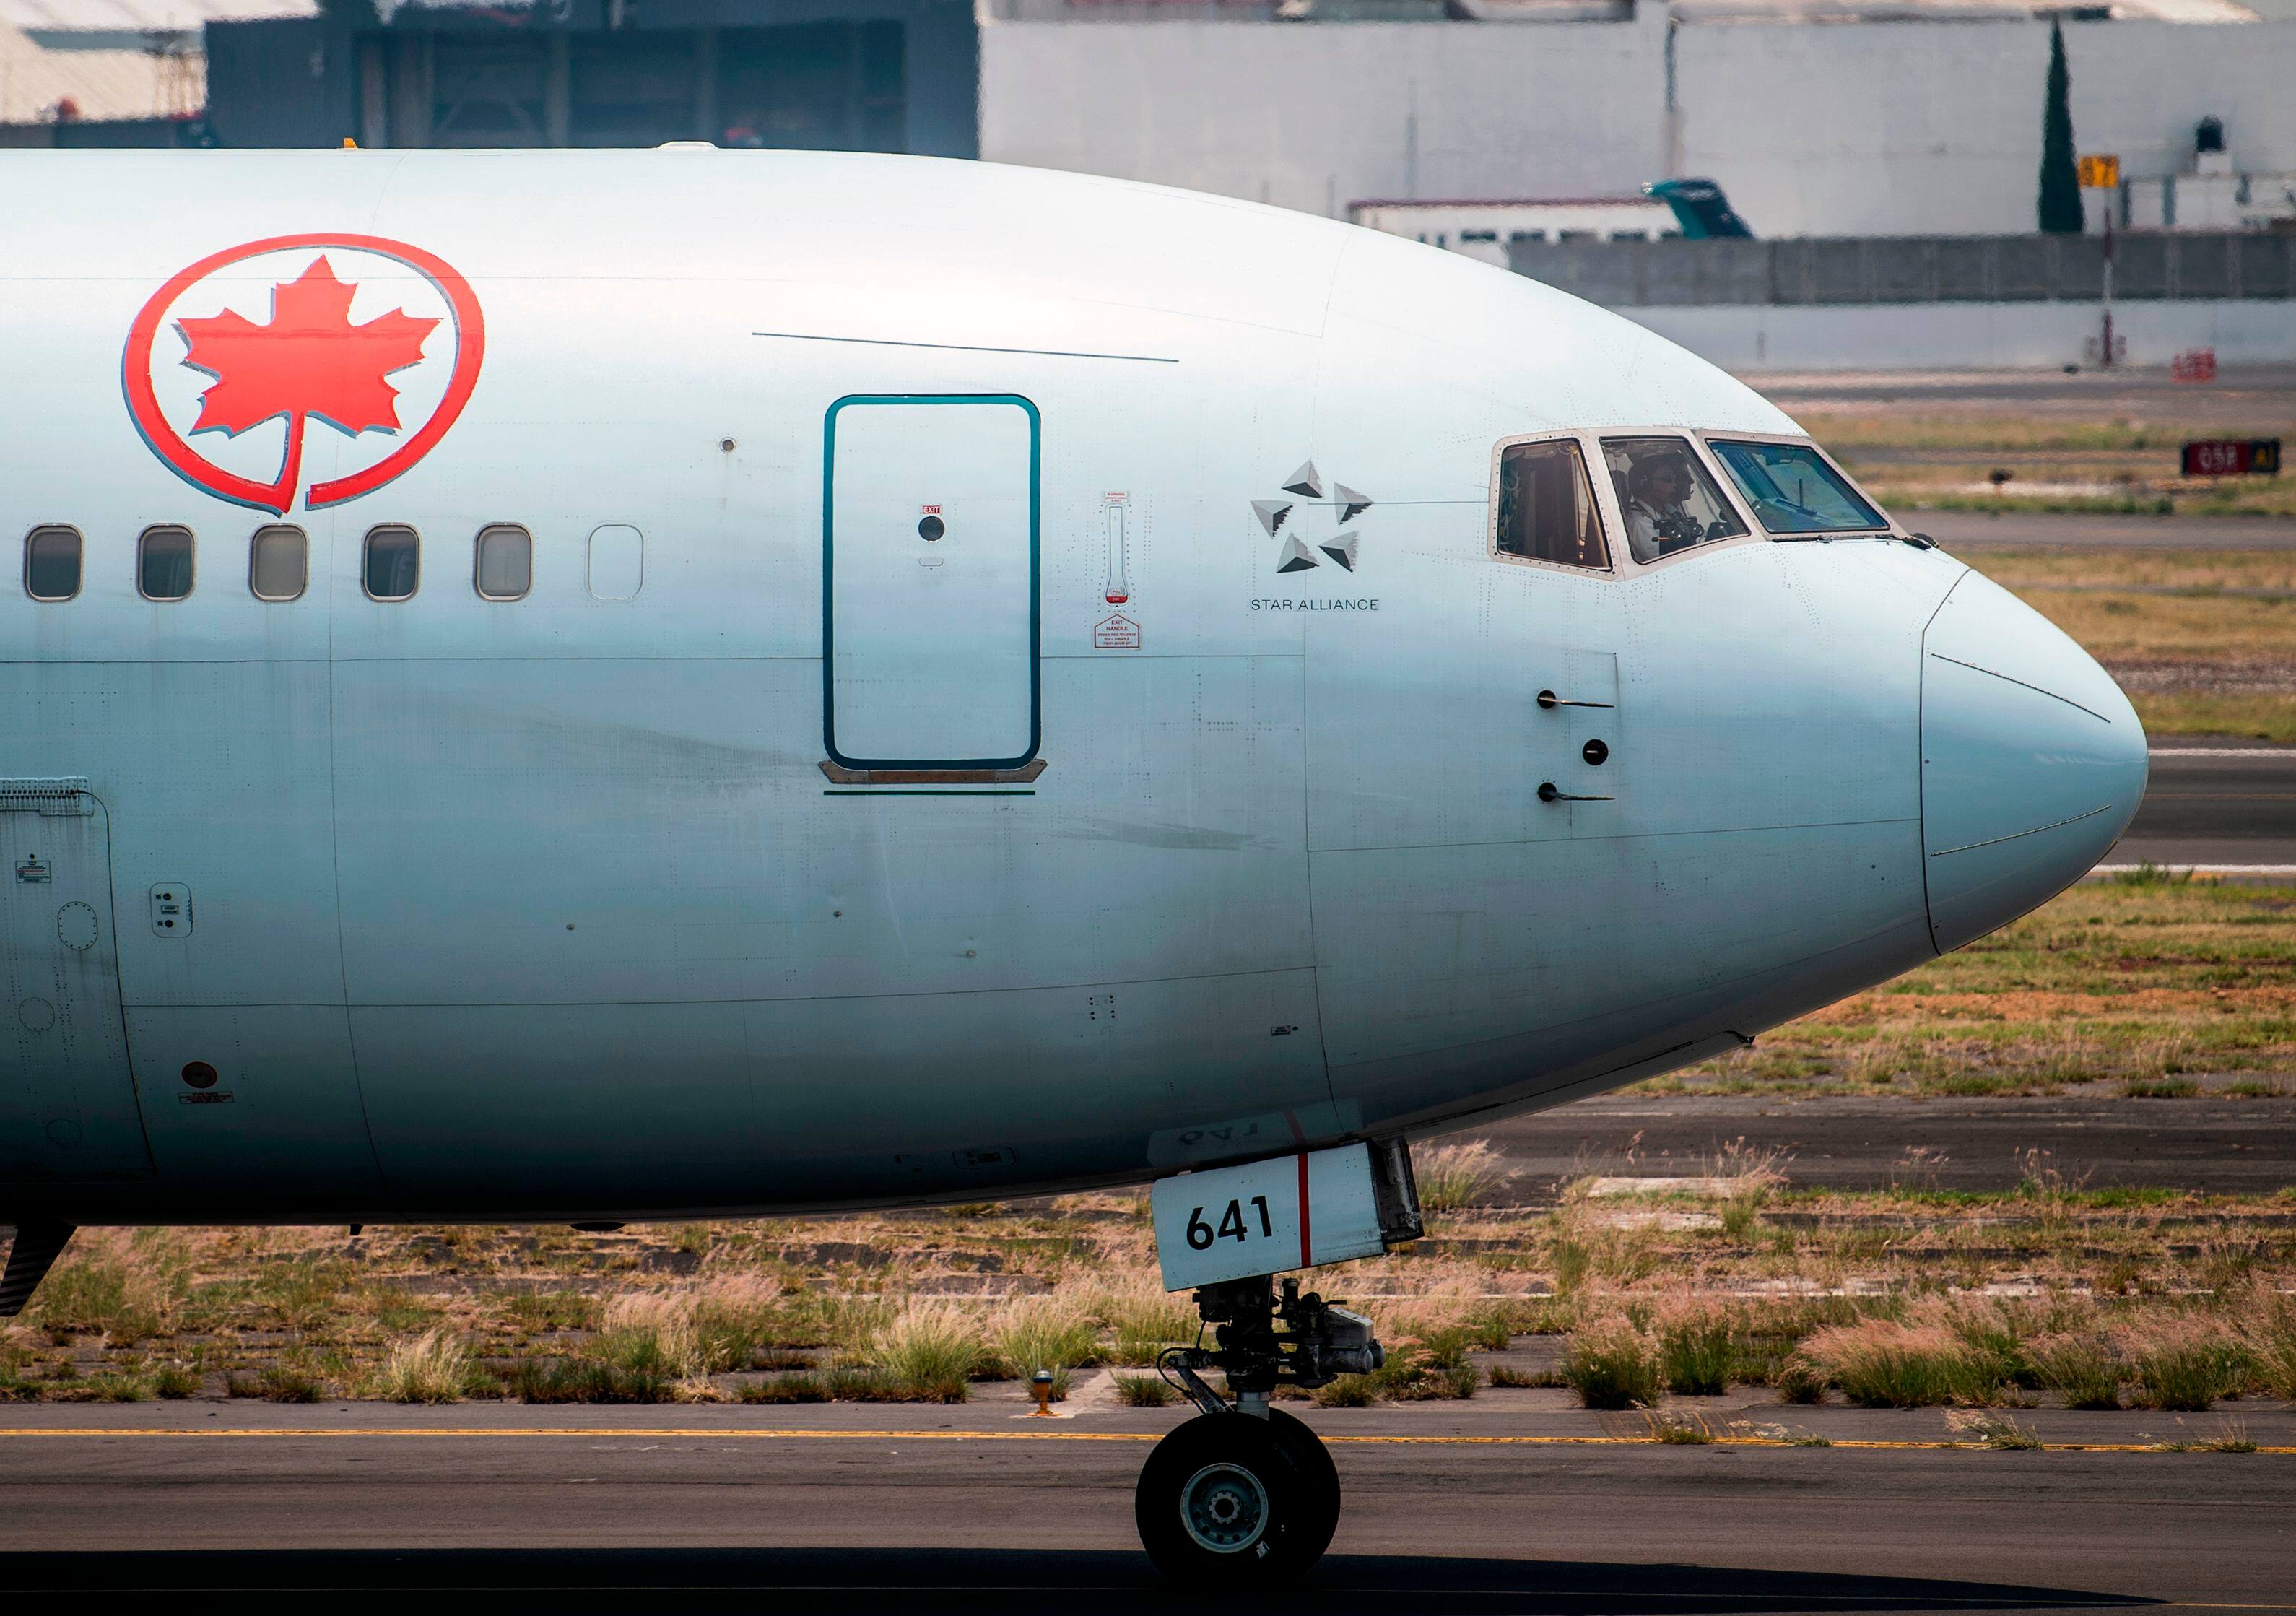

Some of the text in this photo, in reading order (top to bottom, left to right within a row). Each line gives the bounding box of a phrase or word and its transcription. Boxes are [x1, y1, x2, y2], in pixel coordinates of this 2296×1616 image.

[1251, 599, 1380, 611] STAR ALLIANCE
[1186, 1195, 1272, 1251] 641
